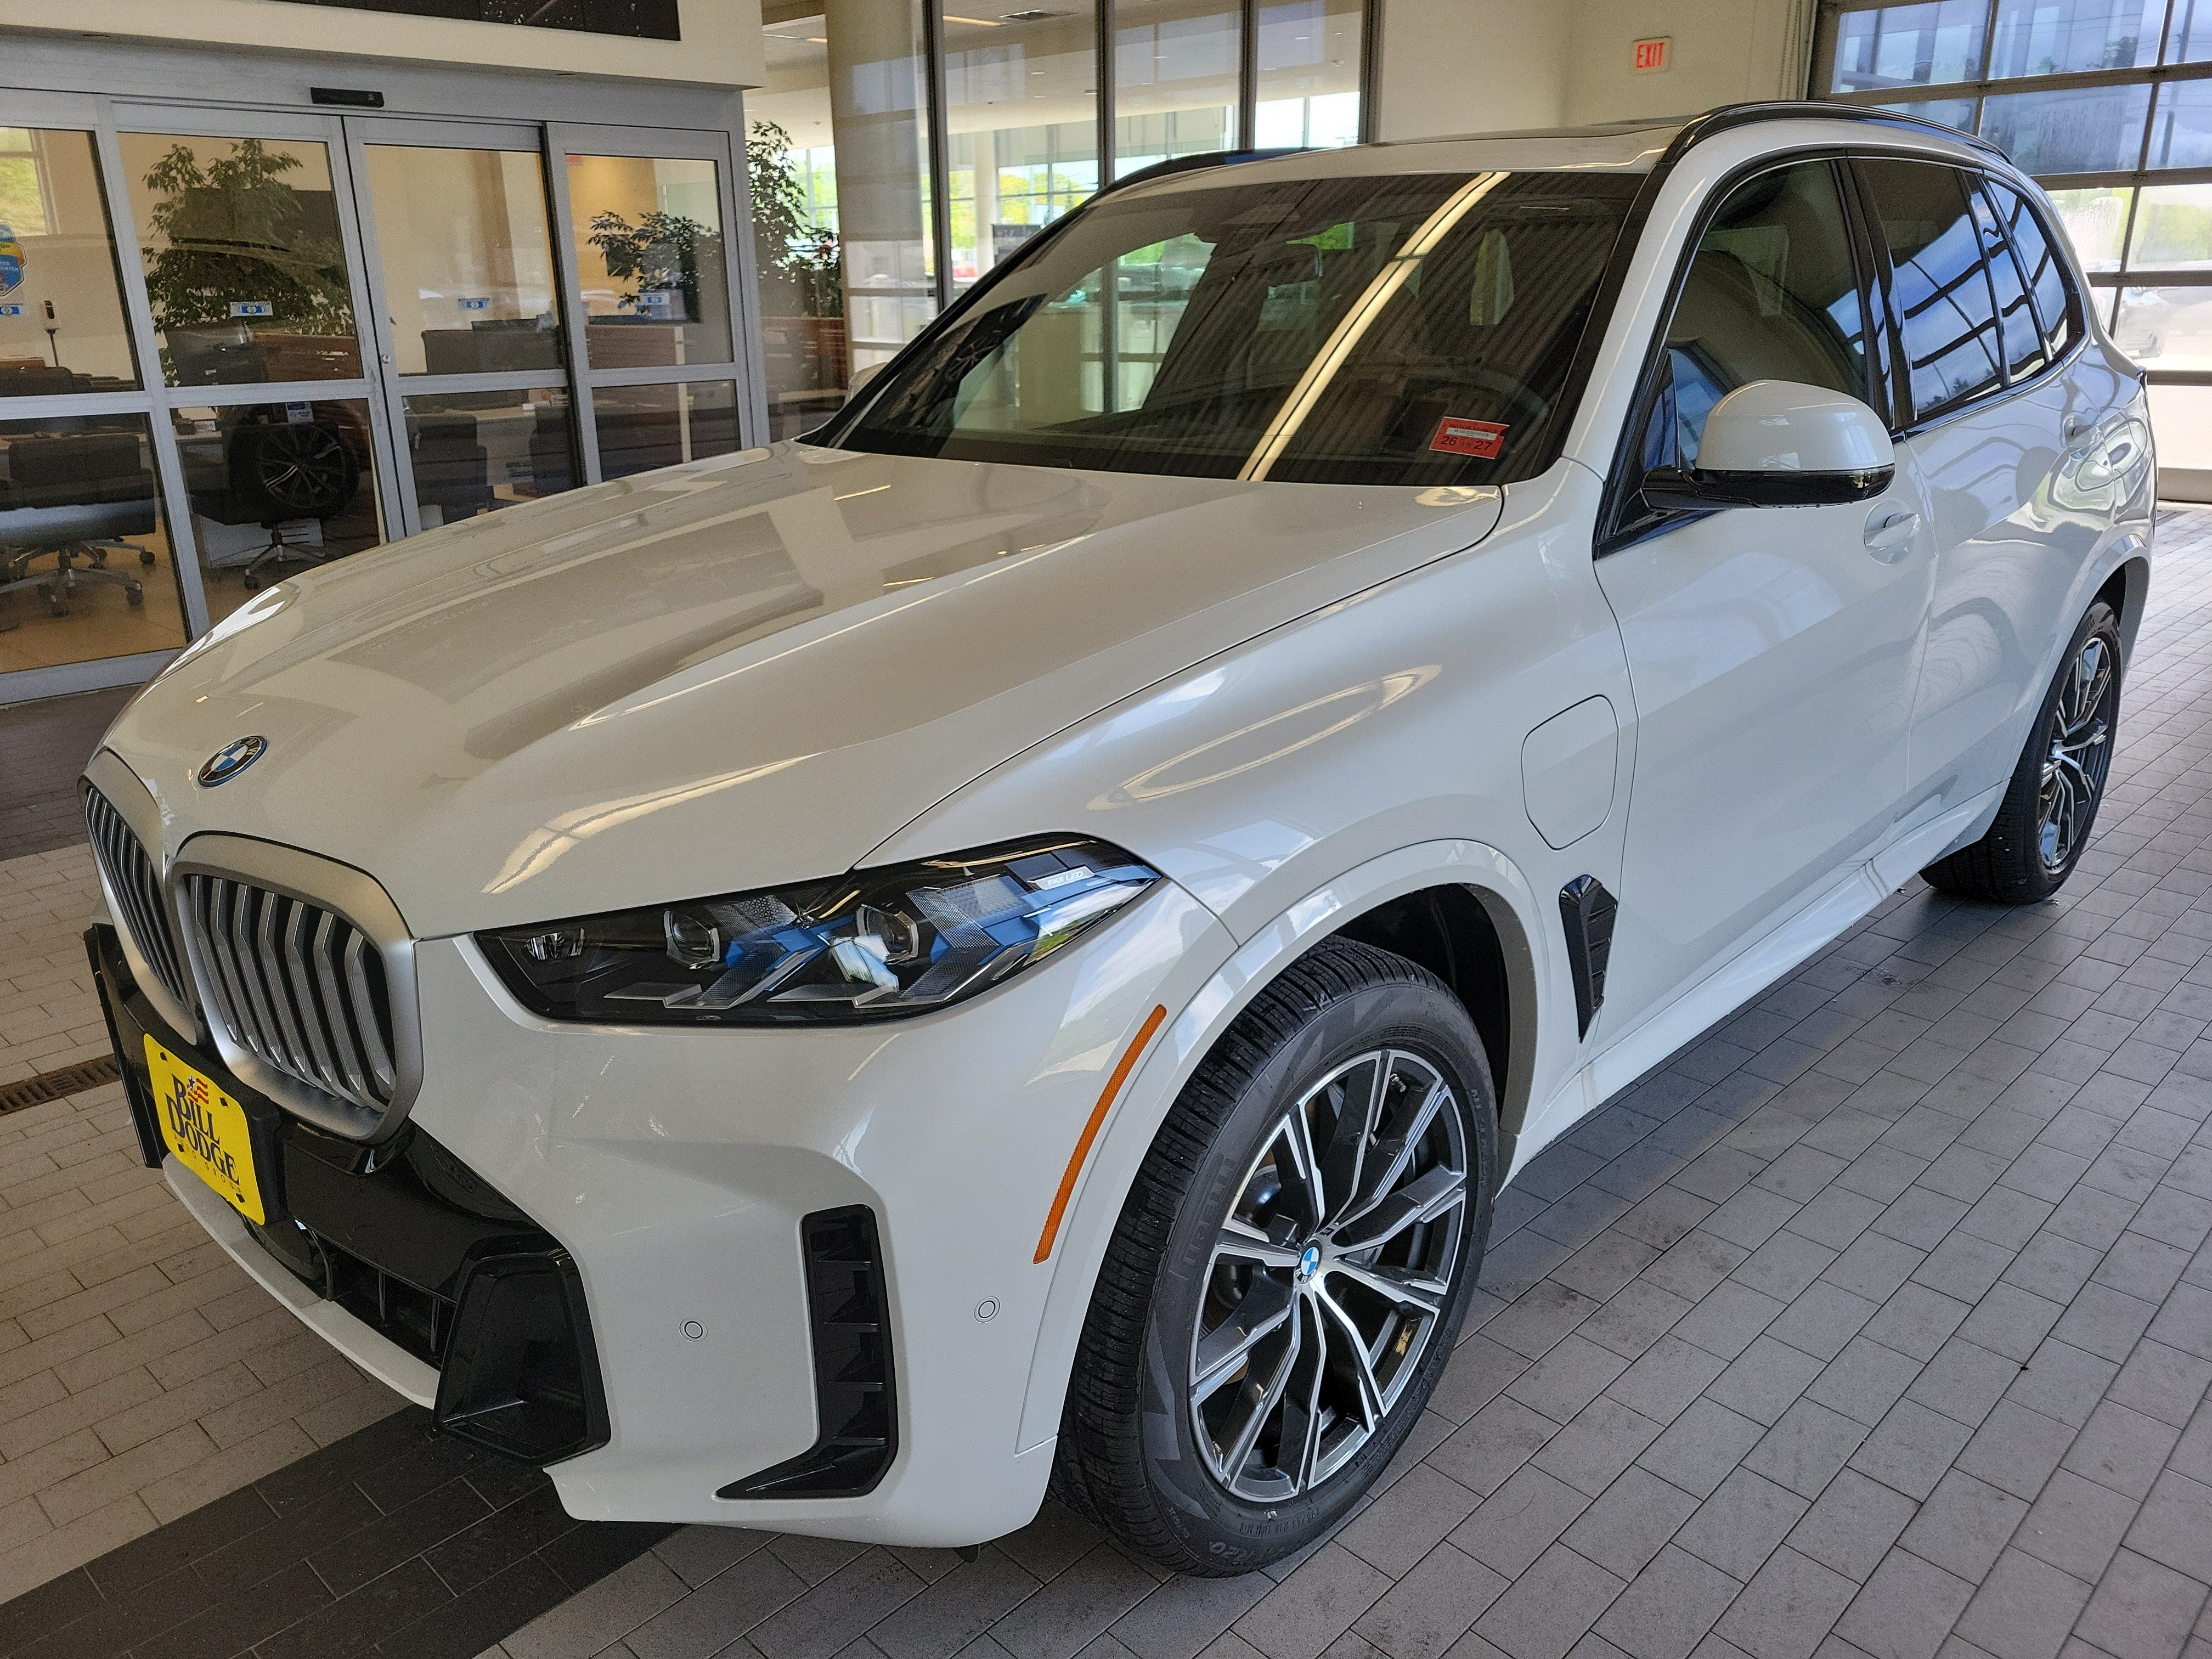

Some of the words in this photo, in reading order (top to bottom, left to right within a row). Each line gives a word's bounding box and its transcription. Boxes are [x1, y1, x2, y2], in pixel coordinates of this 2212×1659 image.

[1636, 42, 1664, 69] EXIT
[1440, 436, 1458, 445] 26
[1473, 440, 1494, 451] 27
[1047, 876, 1064, 887] BMW
[1065, 871, 1084, 881] LED
[172, 1074, 220, 1144] BILL
[166, 1092, 240, 1185] DODGE
[1177, 1152, 1238, 1266] PIRELLI
